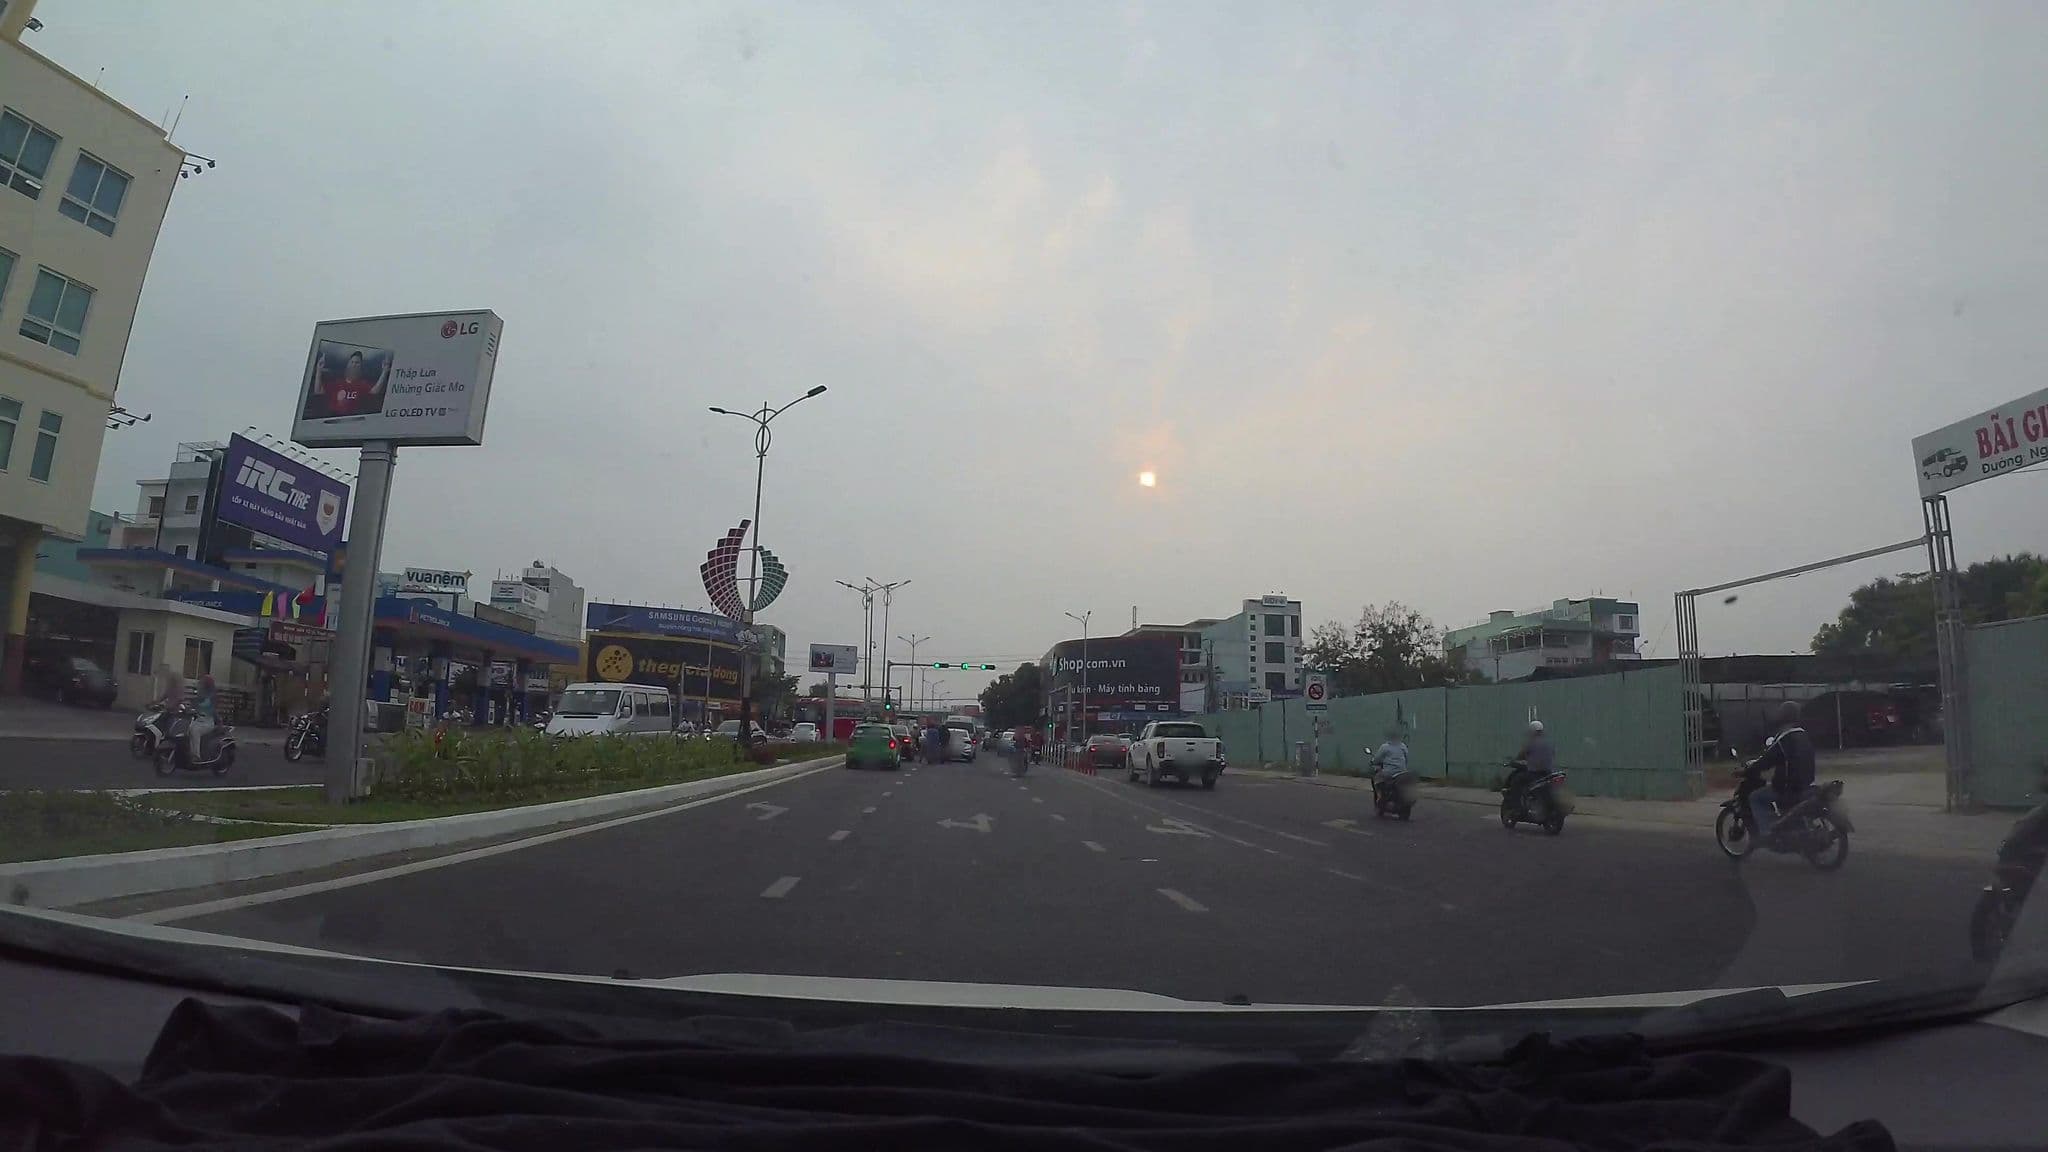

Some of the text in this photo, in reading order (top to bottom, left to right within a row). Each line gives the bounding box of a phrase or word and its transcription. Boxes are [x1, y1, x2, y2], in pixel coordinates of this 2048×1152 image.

[459, 321, 479, 335] LG
[384, 408, 398, 418] LG
[399, 407, 424, 418] OLED
[425, 407, 438, 417] TV
[1975, 404, 2048, 459] BÃI GI
[2030, 445, 2048, 461] Ng
[286, 487, 312, 511] TIRE
[648, 611, 691, 623] SAMSUNG
[1098, 682, 1116, 697] Máy
